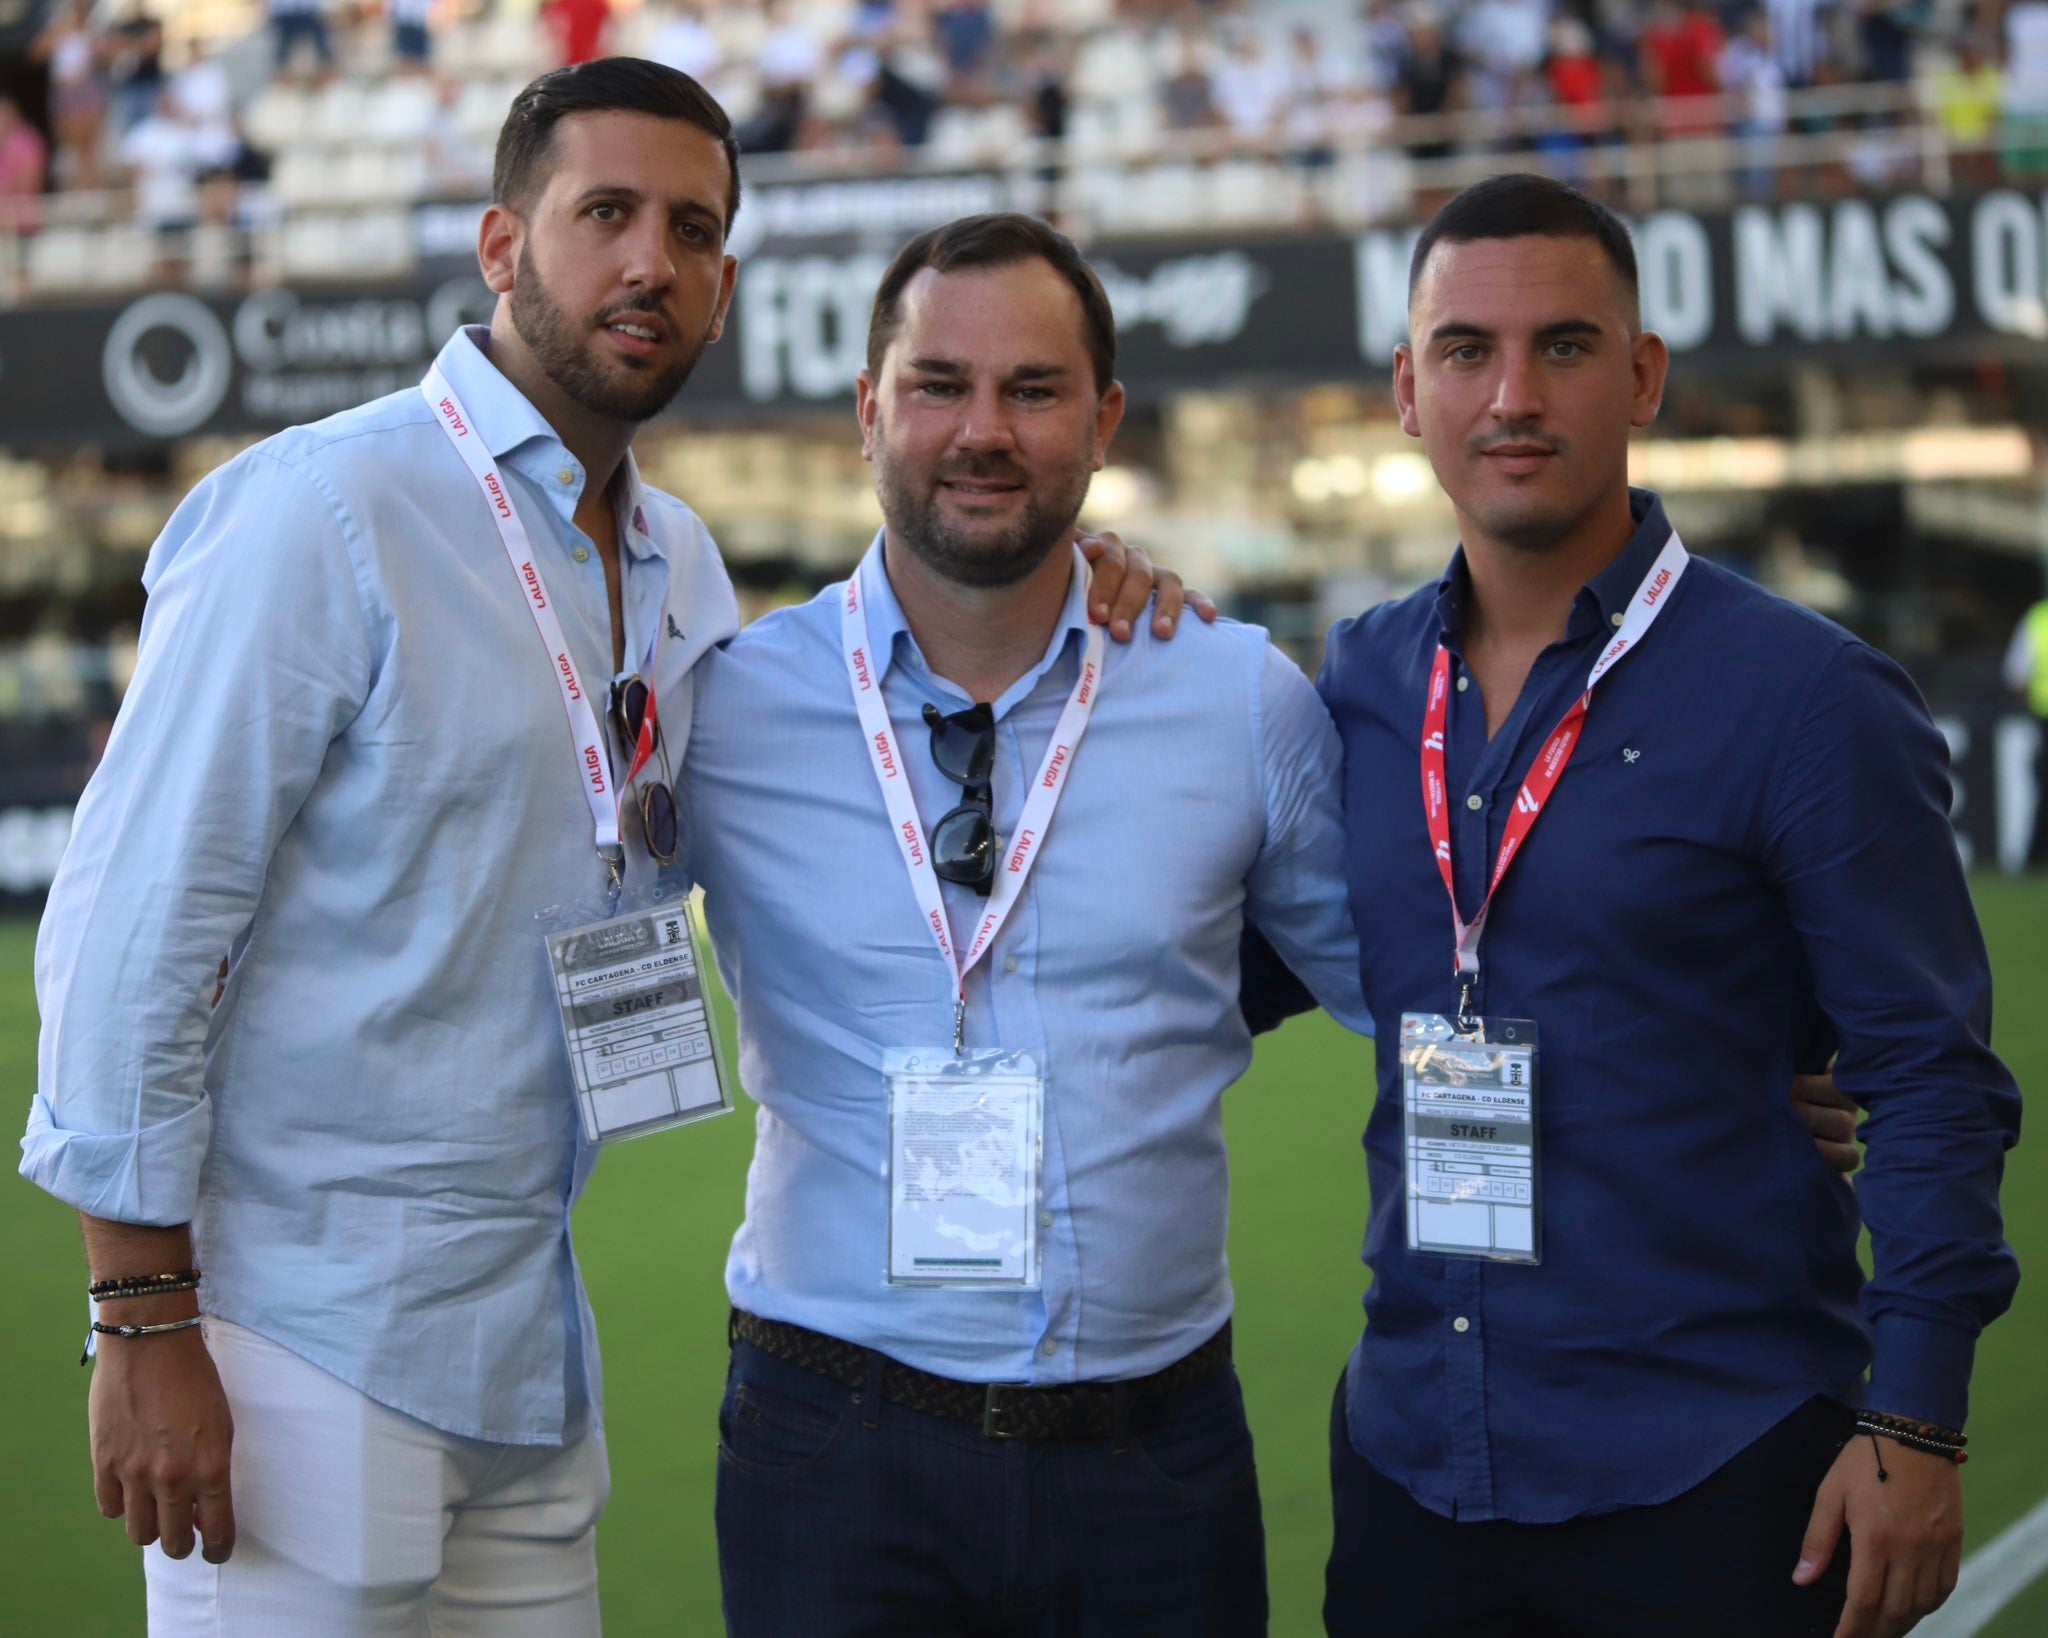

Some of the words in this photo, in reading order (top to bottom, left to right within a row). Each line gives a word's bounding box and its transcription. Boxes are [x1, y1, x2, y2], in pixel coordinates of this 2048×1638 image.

[439, 397, 468, 437] LALIGA
[484, 472, 512, 519] LALIGA
[522, 561, 546, 609] LALIGA
[1643, 568, 1672, 606] LALIGA
[558, 653, 580, 700] LALIGA
[853, 647, 871, 691] LALIGA
[1078, 662, 1095, 704] LALIGA
[585, 745, 605, 794] LALIGA
[874, 731, 897, 778] LALIGA
[1043, 744, 1069, 788] LALIGA
[902, 820, 924, 866] LALIGA
[1009, 829, 1035, 873] LALIGA
[930, 908, 951, 956] LALIGA
[588, 967, 636, 984] CARTAGENA
[641, 963, 652, 971] CD
[654, 953, 689, 967] ELDENSE
[613, 991, 664, 1015] STAFF
[1434, 1092, 1476, 1101] CARTAGENA
[1494, 1097, 1525, 1105] ELDENSE
[1450, 1124, 1497, 1139] STAFF
